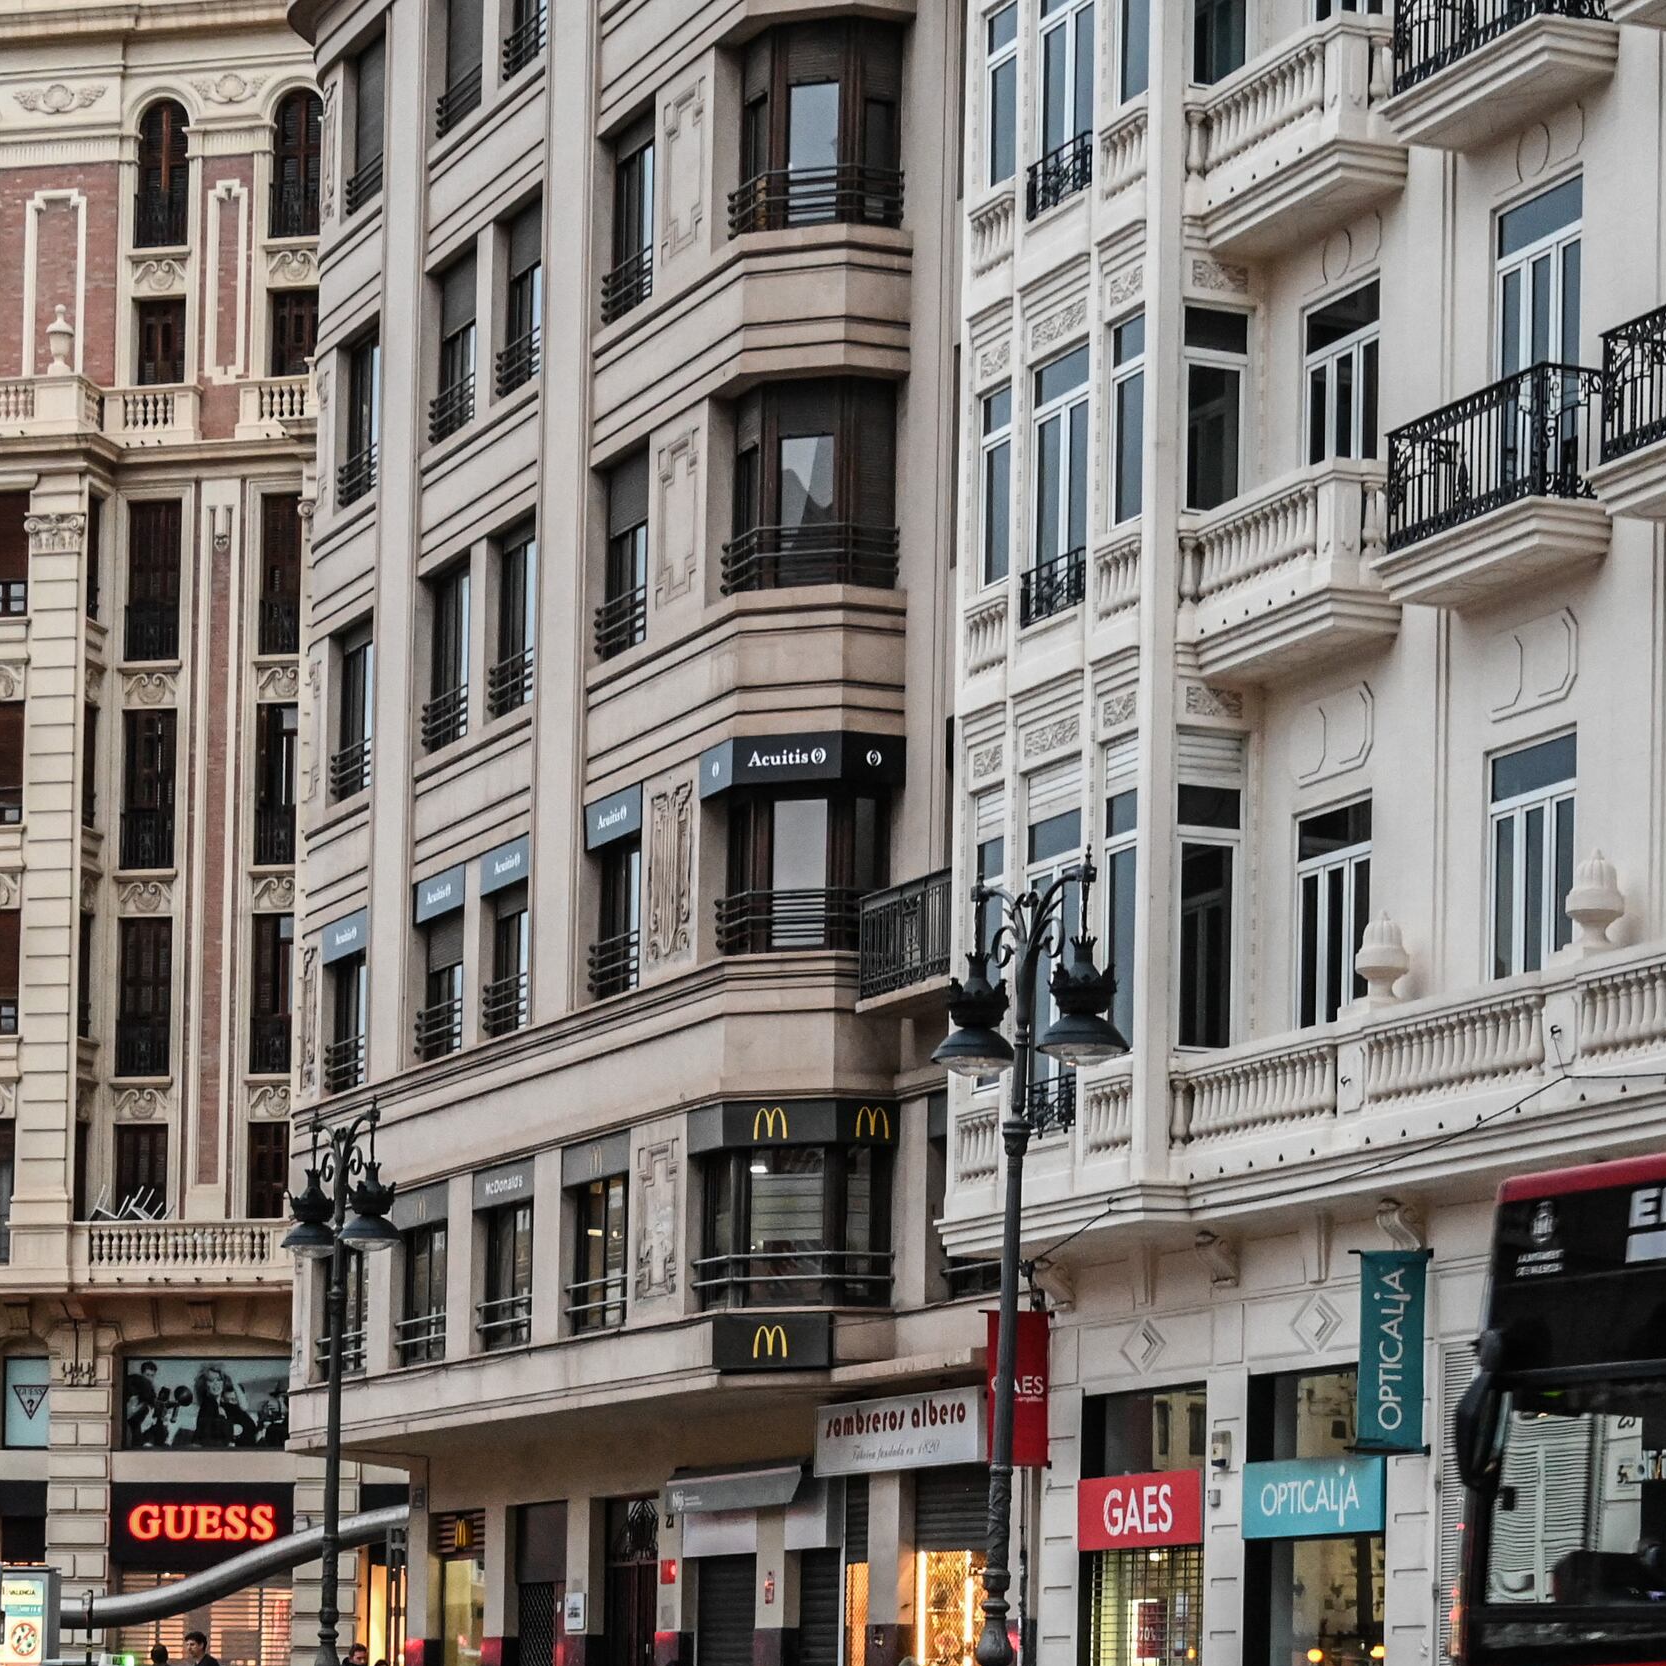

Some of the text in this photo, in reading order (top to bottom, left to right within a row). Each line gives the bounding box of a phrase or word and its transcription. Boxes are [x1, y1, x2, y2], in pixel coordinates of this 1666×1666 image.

[748, 747, 809, 768] Acuitis
[597, 808, 621, 830] Acuitis
[485, 1174, 524, 1196] McDonald's
[826, 1400, 966, 1438] sombreros albero
[128, 1503, 275, 1541] GUESS
[1103, 1484, 1173, 1536] GAES
